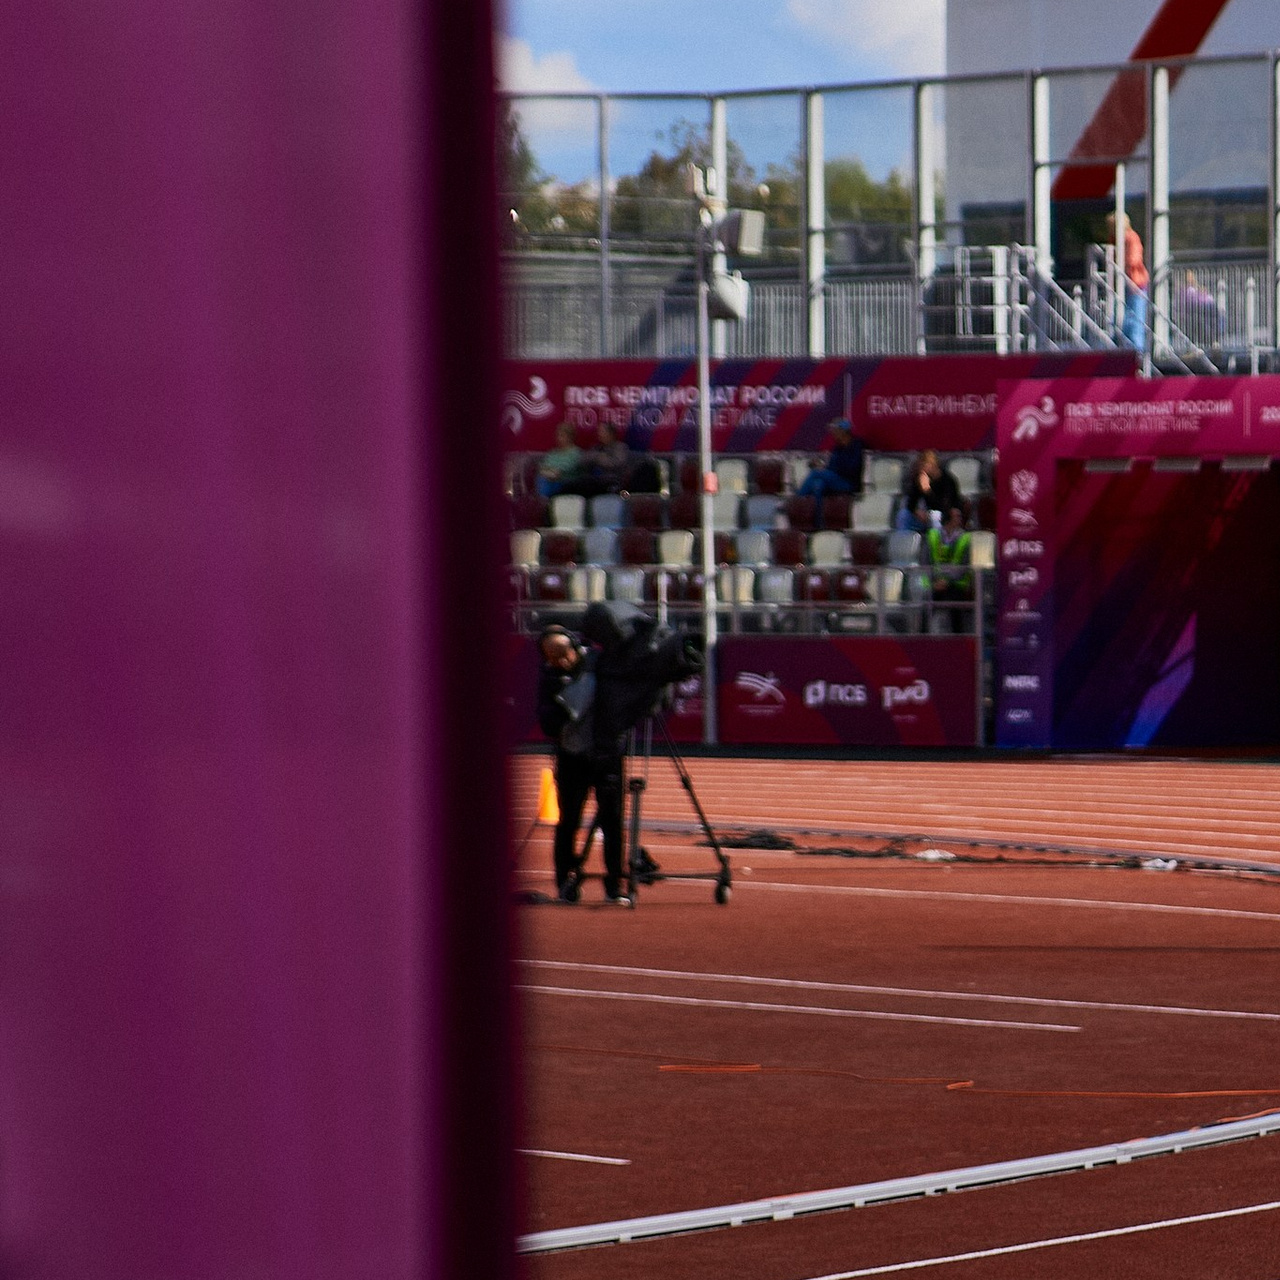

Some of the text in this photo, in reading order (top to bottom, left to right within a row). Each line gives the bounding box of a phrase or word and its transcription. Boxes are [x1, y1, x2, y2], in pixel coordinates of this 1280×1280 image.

[565, 384, 825, 407] ПСБ ЧЕМПИОАТ РОССИИ
[565, 407, 598, 429] ПО
